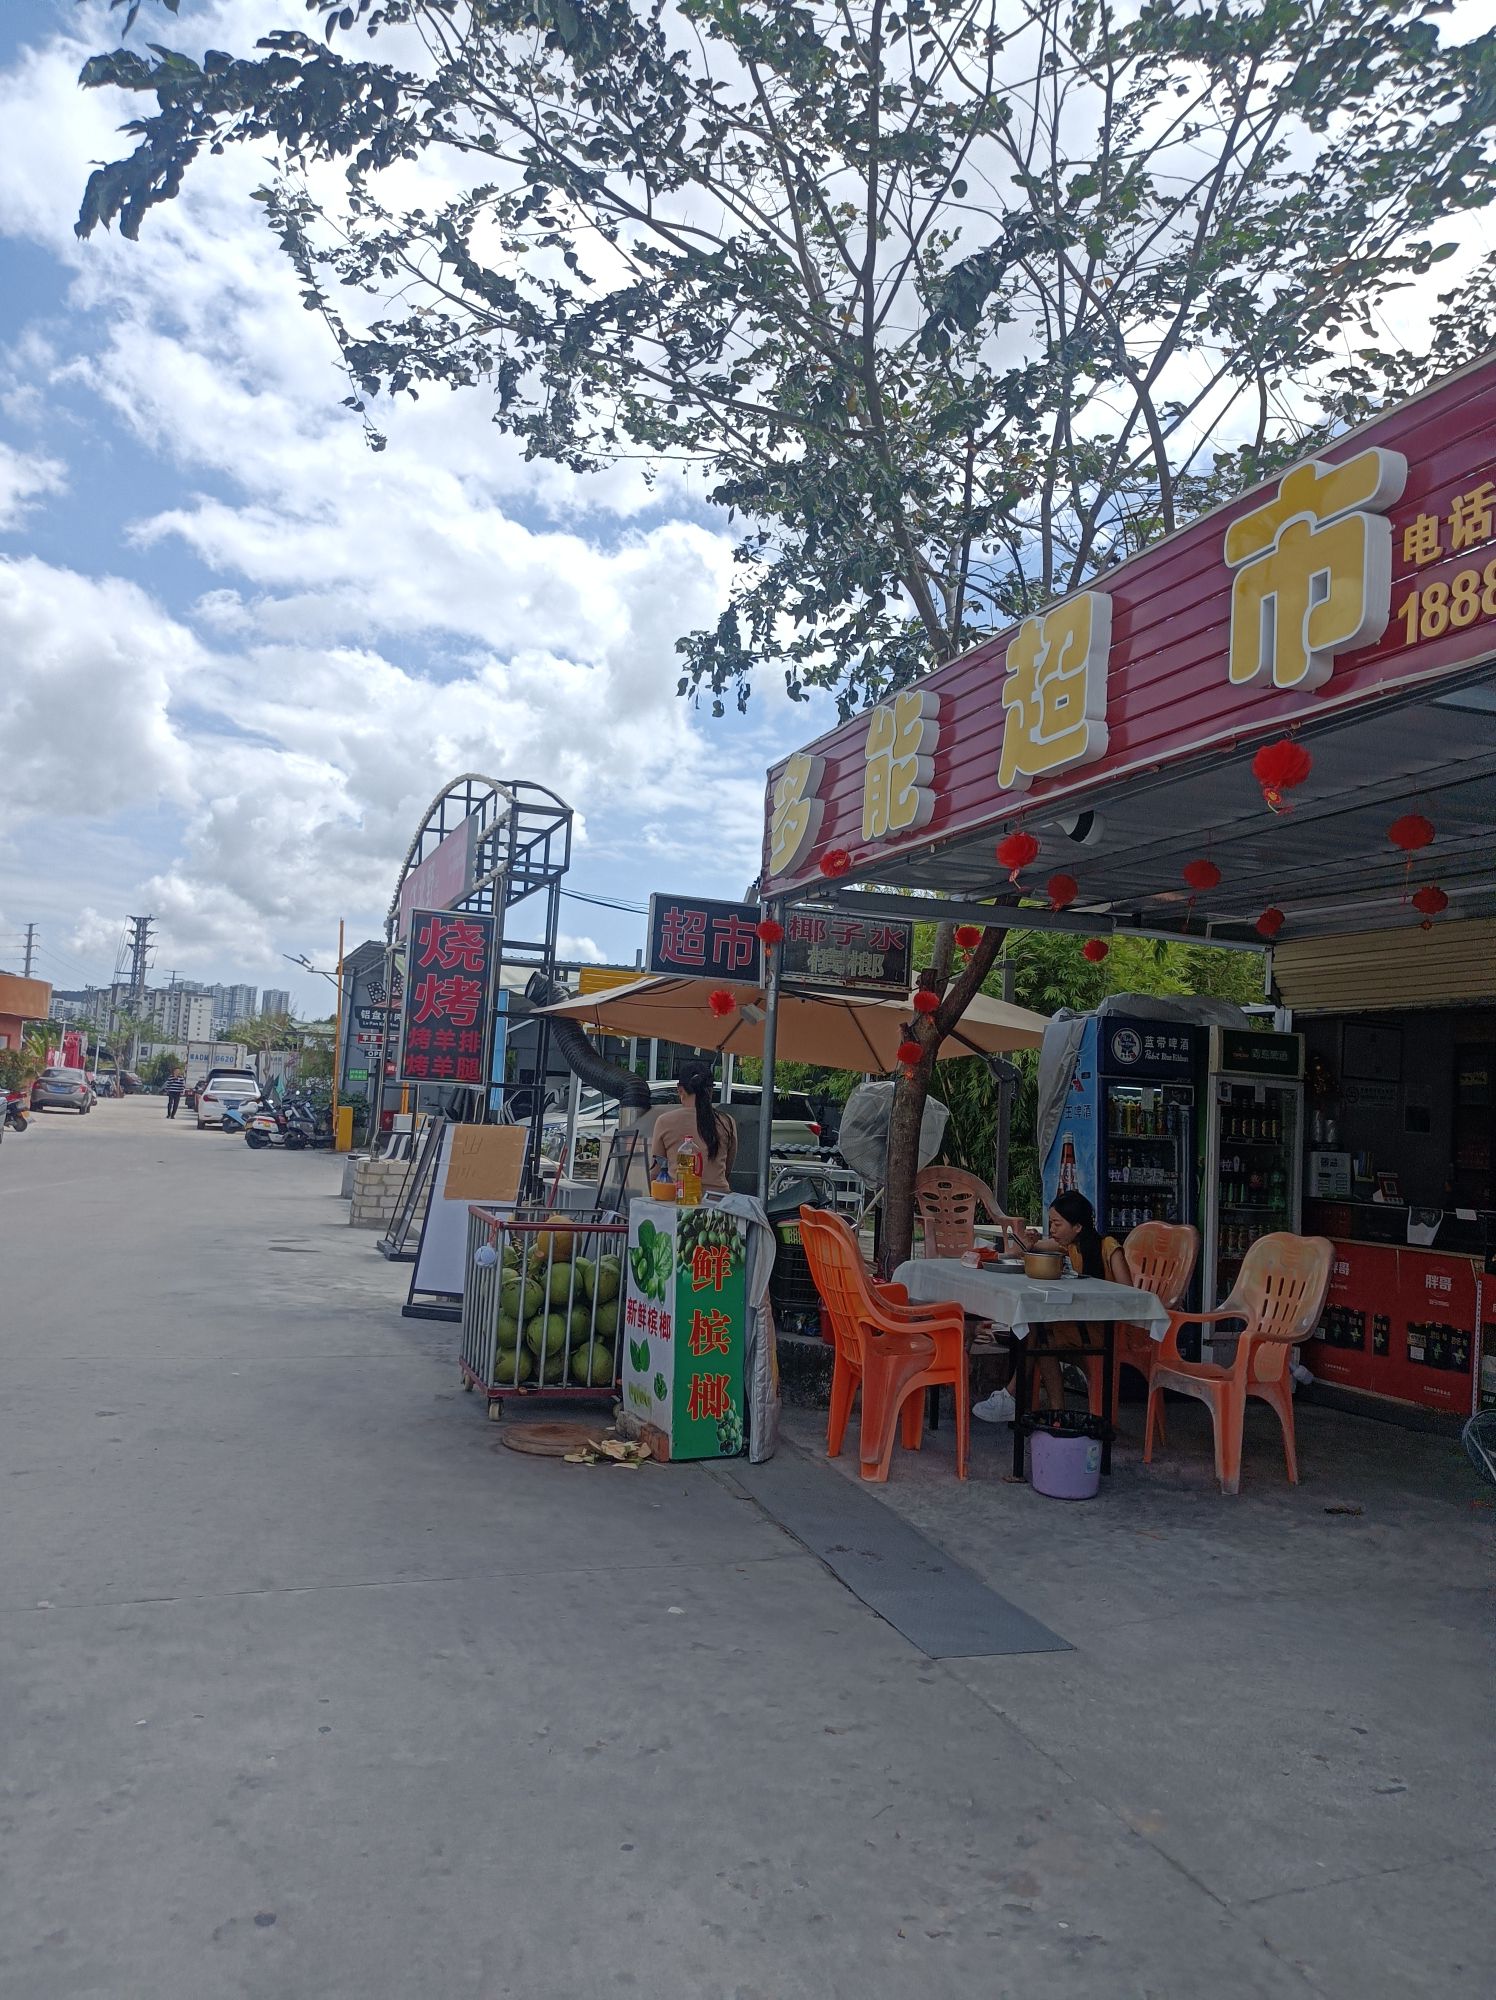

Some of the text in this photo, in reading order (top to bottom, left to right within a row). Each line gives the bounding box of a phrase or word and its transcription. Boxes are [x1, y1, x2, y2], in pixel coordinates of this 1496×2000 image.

[1403, 481, 1496, 565] 电话
[770, 447, 1407, 876] 多能超市
[659, 906, 758, 971] 超市
[789, 915, 905, 951] 椰子水
[413, 917, 486, 1027] 烧烤
[406, 1054, 480, 1081] 烤羊腿
[408, 1027, 481, 1053] 烤羊排
[1425, 1274, 1452, 1292] 胖哥
[626, 1297, 672, 1343] 新鲜槟榔
[687, 1245, 732, 1421] 鲜槟榔
